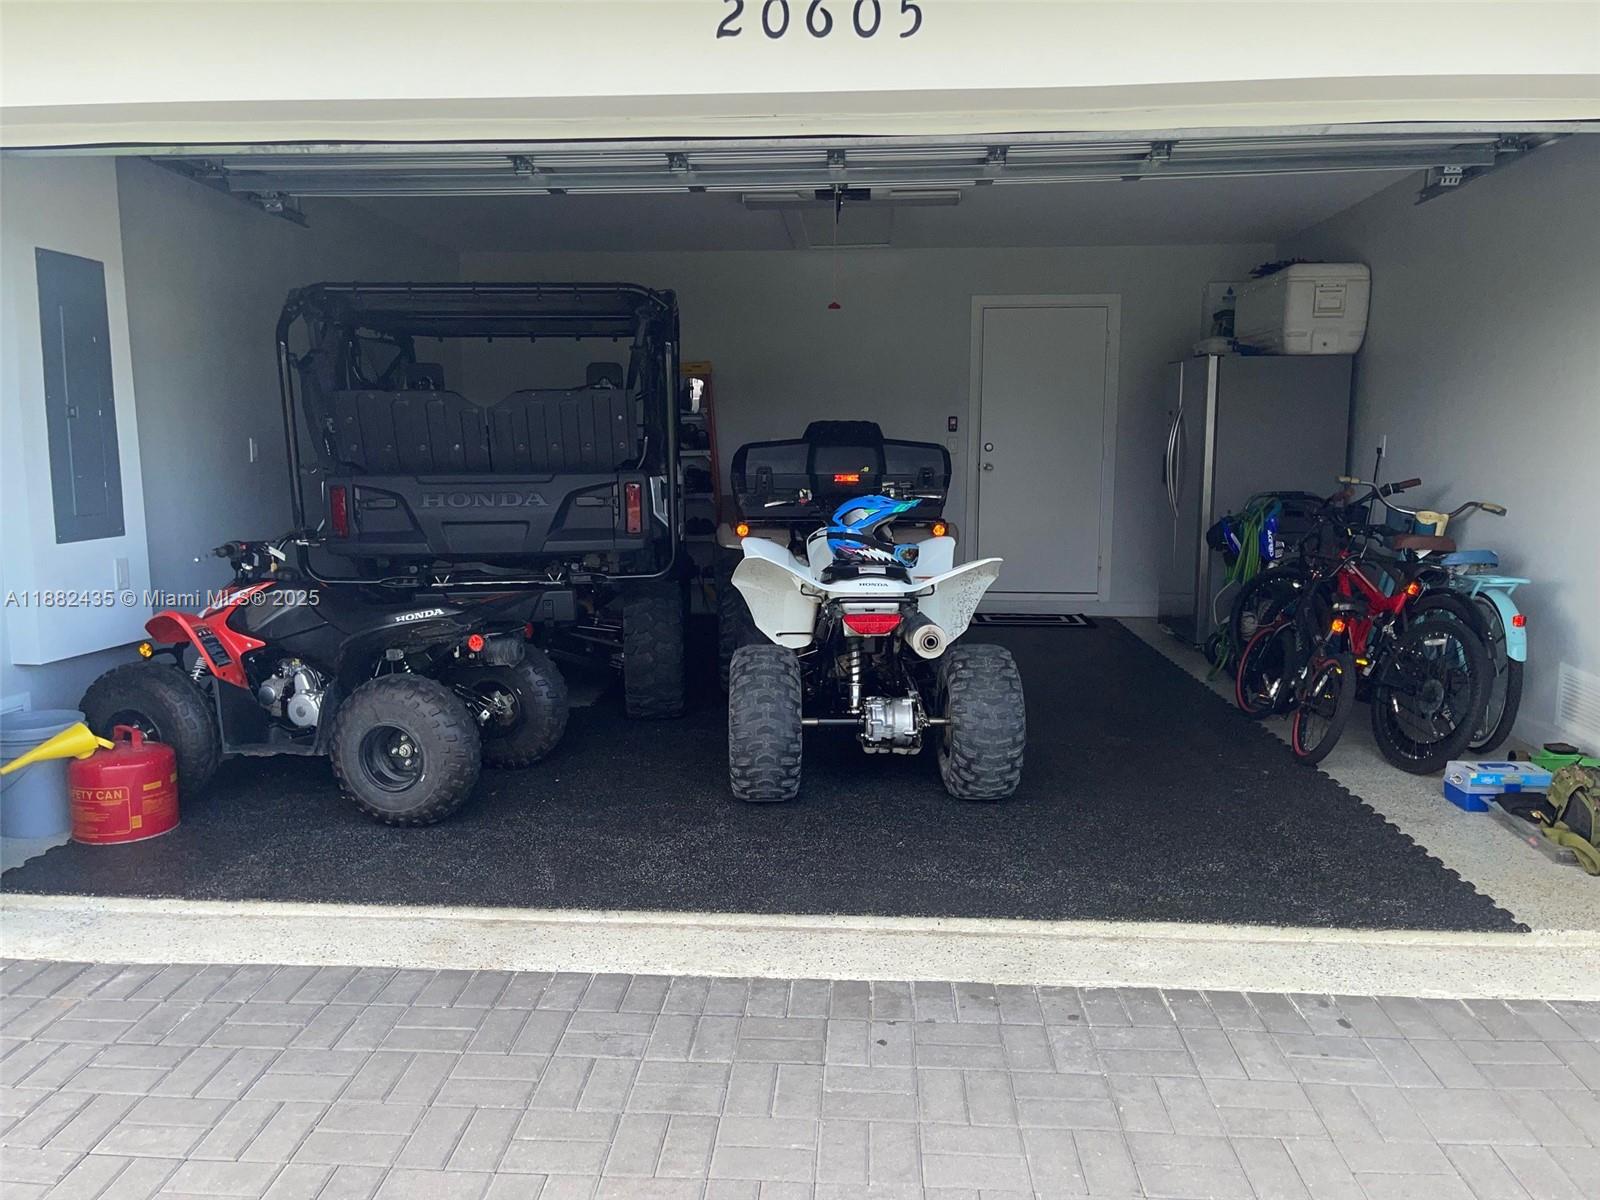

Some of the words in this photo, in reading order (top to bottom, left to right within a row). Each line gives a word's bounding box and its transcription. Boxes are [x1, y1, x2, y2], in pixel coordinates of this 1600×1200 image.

[716, 0, 923, 39] 20605
[421, 493, 549, 508] HONDA
[395, 608, 445, 623] HONDA
[96, 789, 123, 801] CAN
